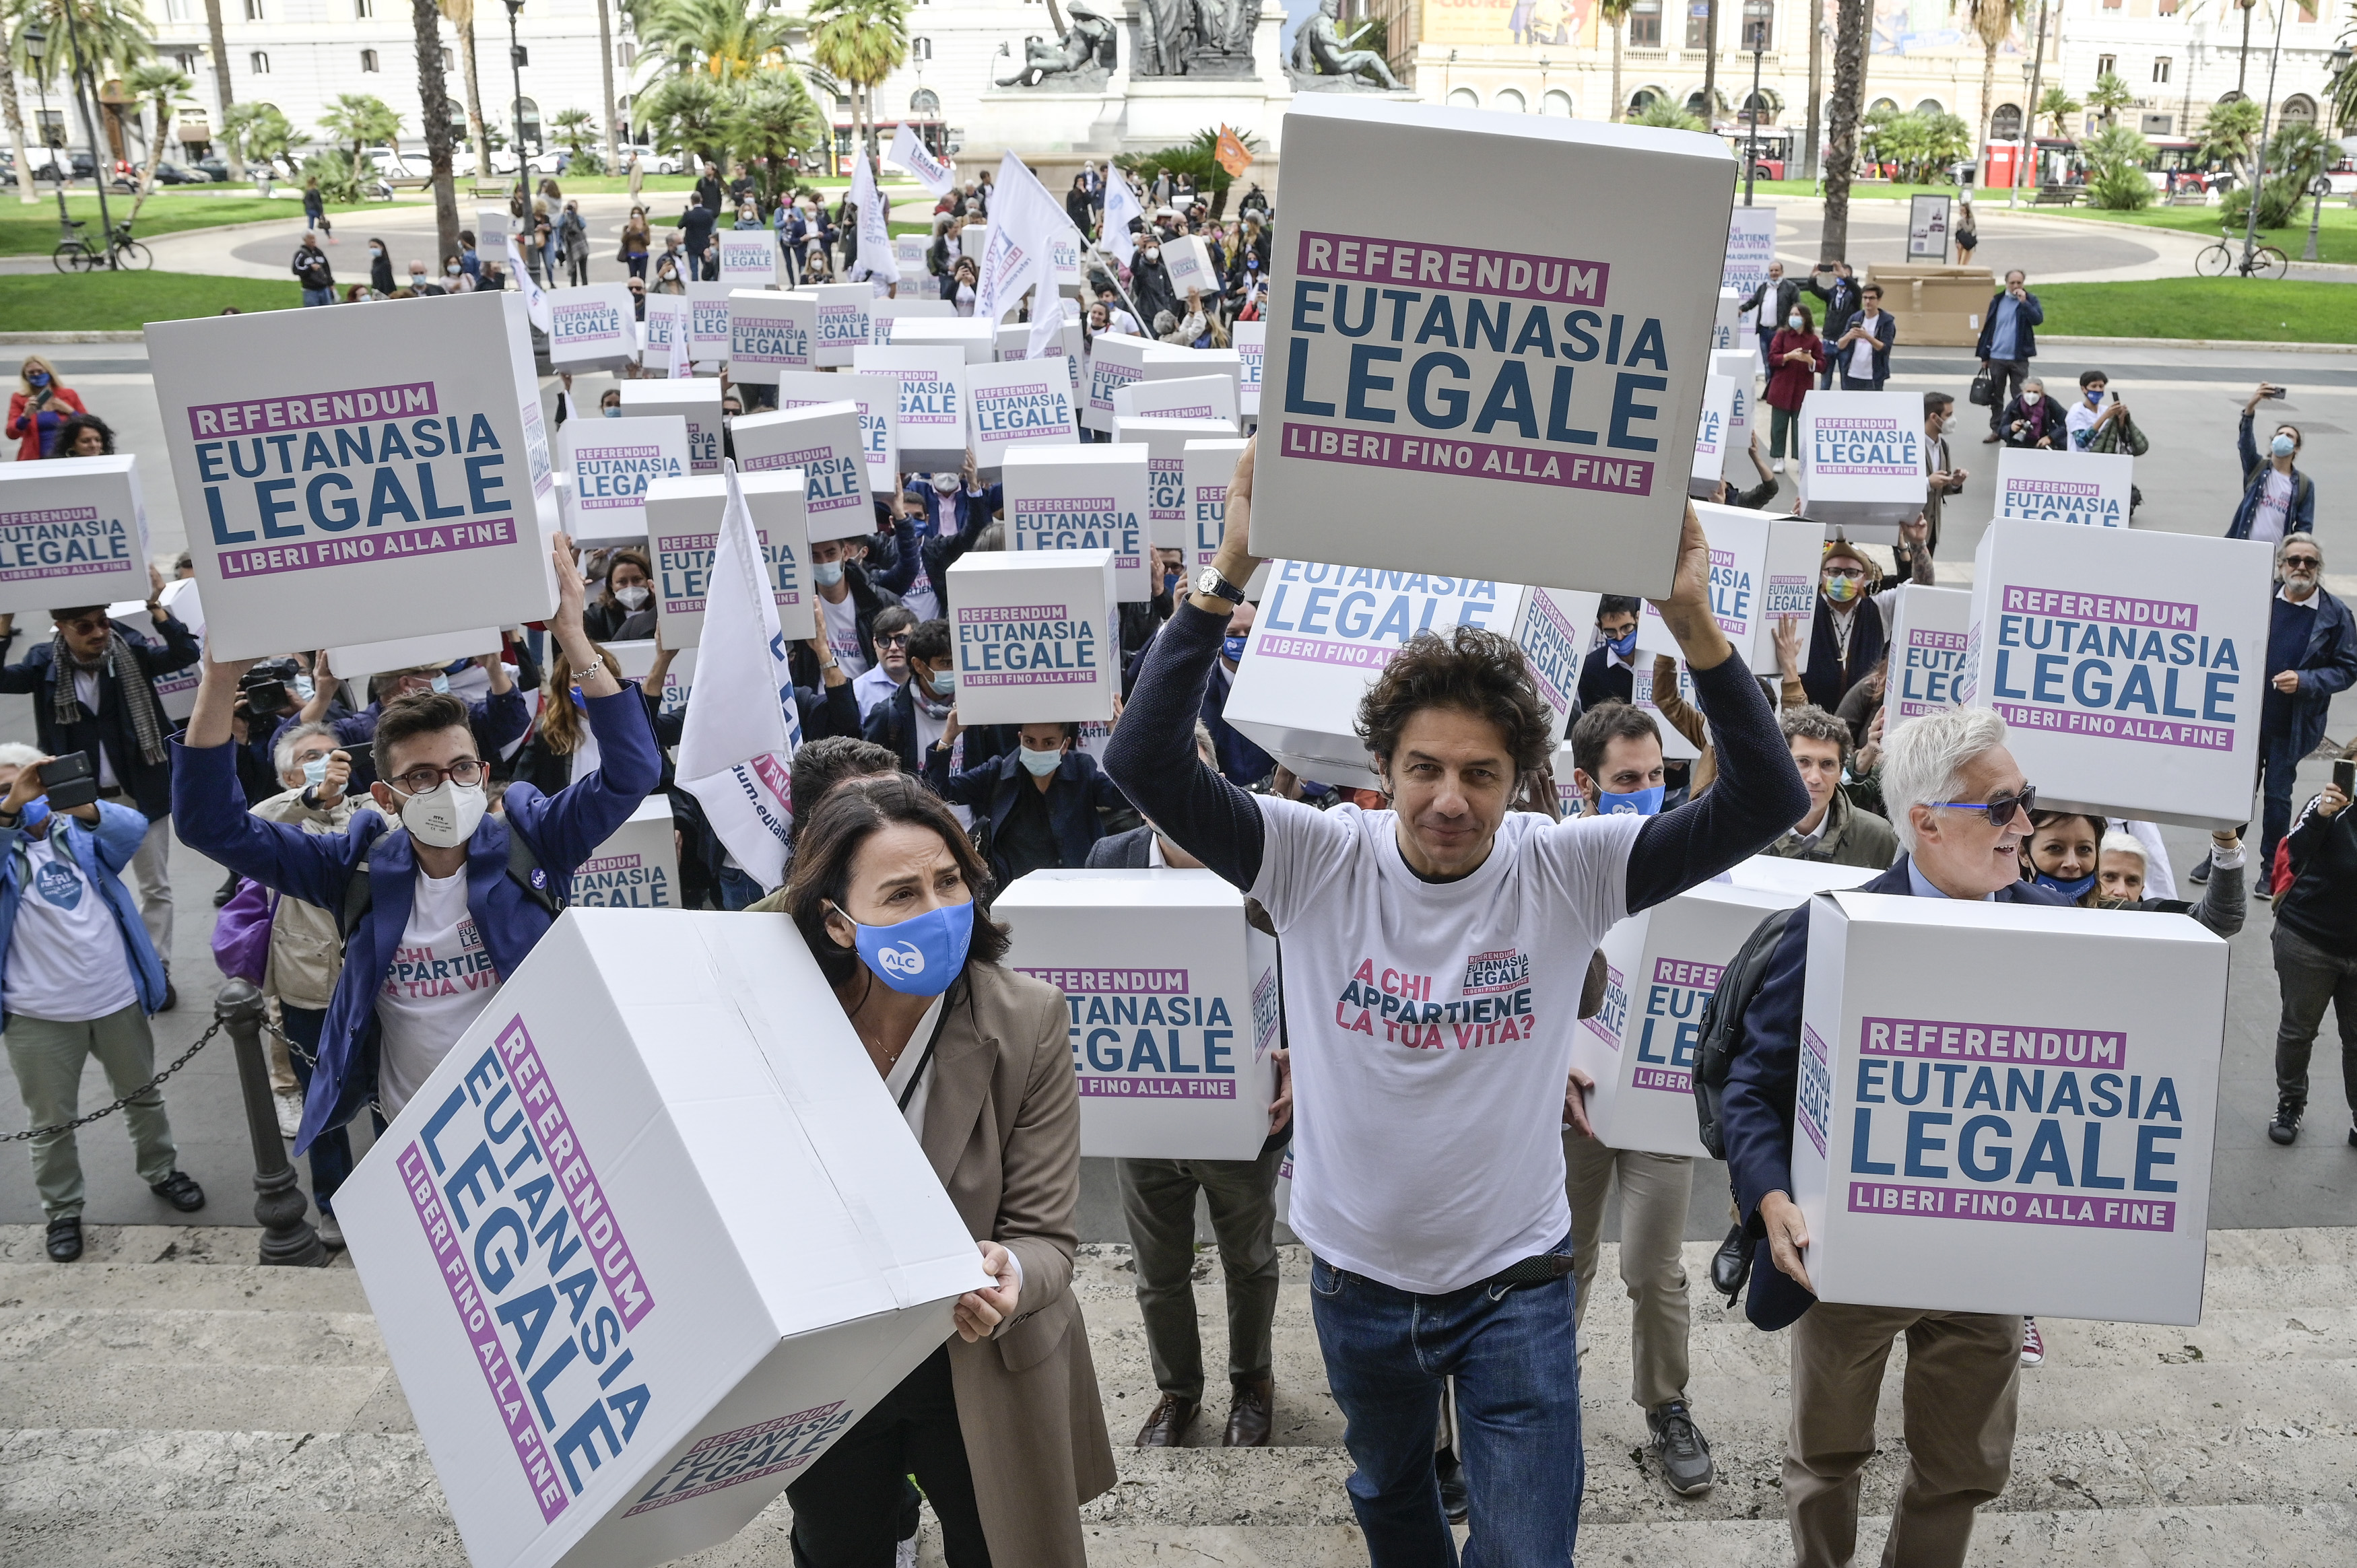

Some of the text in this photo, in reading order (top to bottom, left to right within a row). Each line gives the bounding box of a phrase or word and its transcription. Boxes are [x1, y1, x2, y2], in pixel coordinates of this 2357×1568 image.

[724, 257, 772, 267] LEGALE
[1308, 238, 1599, 299] REFERENDUM
[554, 308, 618, 324] EUTANASIA
[554, 317, 620, 337] LEGALE
[735, 318, 791, 327] REFERENDUM
[1293, 281, 1667, 370] EUTANASIA
[733, 327, 807, 340] EUTANASIA
[733, 337, 807, 355] LEGALE
[976, 393, 1067, 413] EUTANASIA
[977, 384, 1046, 399] REFERENDUM
[1286, 337, 1667, 452] LEGALE
[197, 386, 430, 434] REFERENDUM
[978, 405, 1070, 432] LEGALE
[983, 426, 1069, 440] LIBERI FINO ALLA FINE
[1818, 419, 1894, 429] REFERENDUM
[196, 414, 501, 482] EUTANASIA
[1816, 429, 1916, 444] EUTANASIA
[578, 446, 657, 459] REFERENDUM
[747, 448, 830, 469] REFERENDUM
[1291, 429, 1643, 487] LIBERI FINO ALLA FINE
[1816, 443, 1917, 465] LEGALE
[577, 457, 680, 476] EUTANASIA
[205, 454, 512, 545] LEGALE
[2010, 480, 2096, 496] REFERENDUM
[584, 498, 636, 508] LIBERI FINO
[835, 496, 858, 506] FINE
[1018, 499, 1112, 512] REFERENDUM
[2005, 492, 2120, 515] EUTANASIA
[1, 508, 94, 525] EFERENDUM
[1016, 512, 1139, 531] EUTANASIA
[226, 522, 508, 573] LIBERI FINO ALLA FINE
[3, 562, 128, 580] LIBERI FINO ALLA FINE
[1768, 584, 1813, 596] EUTANASIA
[961, 607, 1063, 621] REFERENDUM
[1535, 588, 1574, 640] REFERENDUM
[1766, 595, 1813, 611] LEGALE
[2009, 589, 2191, 627] REFERENDUM
[960, 621, 1094, 643] EUTANASIA
[1529, 601, 1579, 674] EUTANASIA
[1722, 620, 1744, 632] FINE
[1261, 638, 1368, 663] LIBERI FINO
[1913, 632, 1966, 649] REFER
[1999, 615, 2238, 671] EUTANASIA
[961, 640, 1096, 672] LEGALE
[966, 672, 1093, 685] LIBERI FINO ALLA FINE
[1994, 649, 2239, 722] LEGALE
[1541, 677, 1566, 712] ALLA FINE
[1997, 706, 2227, 747] LIBERI FINO ALLA FINE
[533, 869, 546, 886] Volt
[395, 947, 434, 963] CHI
[886, 954, 915, 968] ALC
[1466, 953, 1529, 974] EUTANASIA
[1469, 949, 1515, 963] REFERENDUM
[403, 968, 501, 998] TUA VIT
[1354, 957, 1432, 1002] A CHI
[1463, 962, 1529, 988] LEGALE
[1066, 995, 1233, 1027] TANASIA
[1339, 980, 1532, 1025] APPARTIENE
[1254, 991, 1277, 1050] LEGALE
[1335, 1000, 1535, 1050] LA TUA VITA?
[1869, 1022, 2117, 1064] REFERENDUM
[1092, 1077, 1230, 1095] FINO ALLA FINE
[1857, 1058, 2181, 1121] EUTANASIA
[1799, 1067, 1830, 1139] LEGALE
[1851, 1107, 2182, 1192] LEGALE
[502, 1025, 647, 1318] REFERENDUM
[1280, 1163, 1292, 1176] FI
[1856, 1186, 2166, 1225] LIBERI FINO ALLA FINE
[465, 1048, 651, 1442] EUTANASIA
[421, 1084, 622, 1495] LEGALE
[404, 1151, 561, 1509] LIBERI FINO ALLA FINE
[694, 1403, 840, 1452] REFERENDUM
[667, 1409, 856, 1474] EUTANASIA
[638, 1426, 843, 1502] LEGALE
